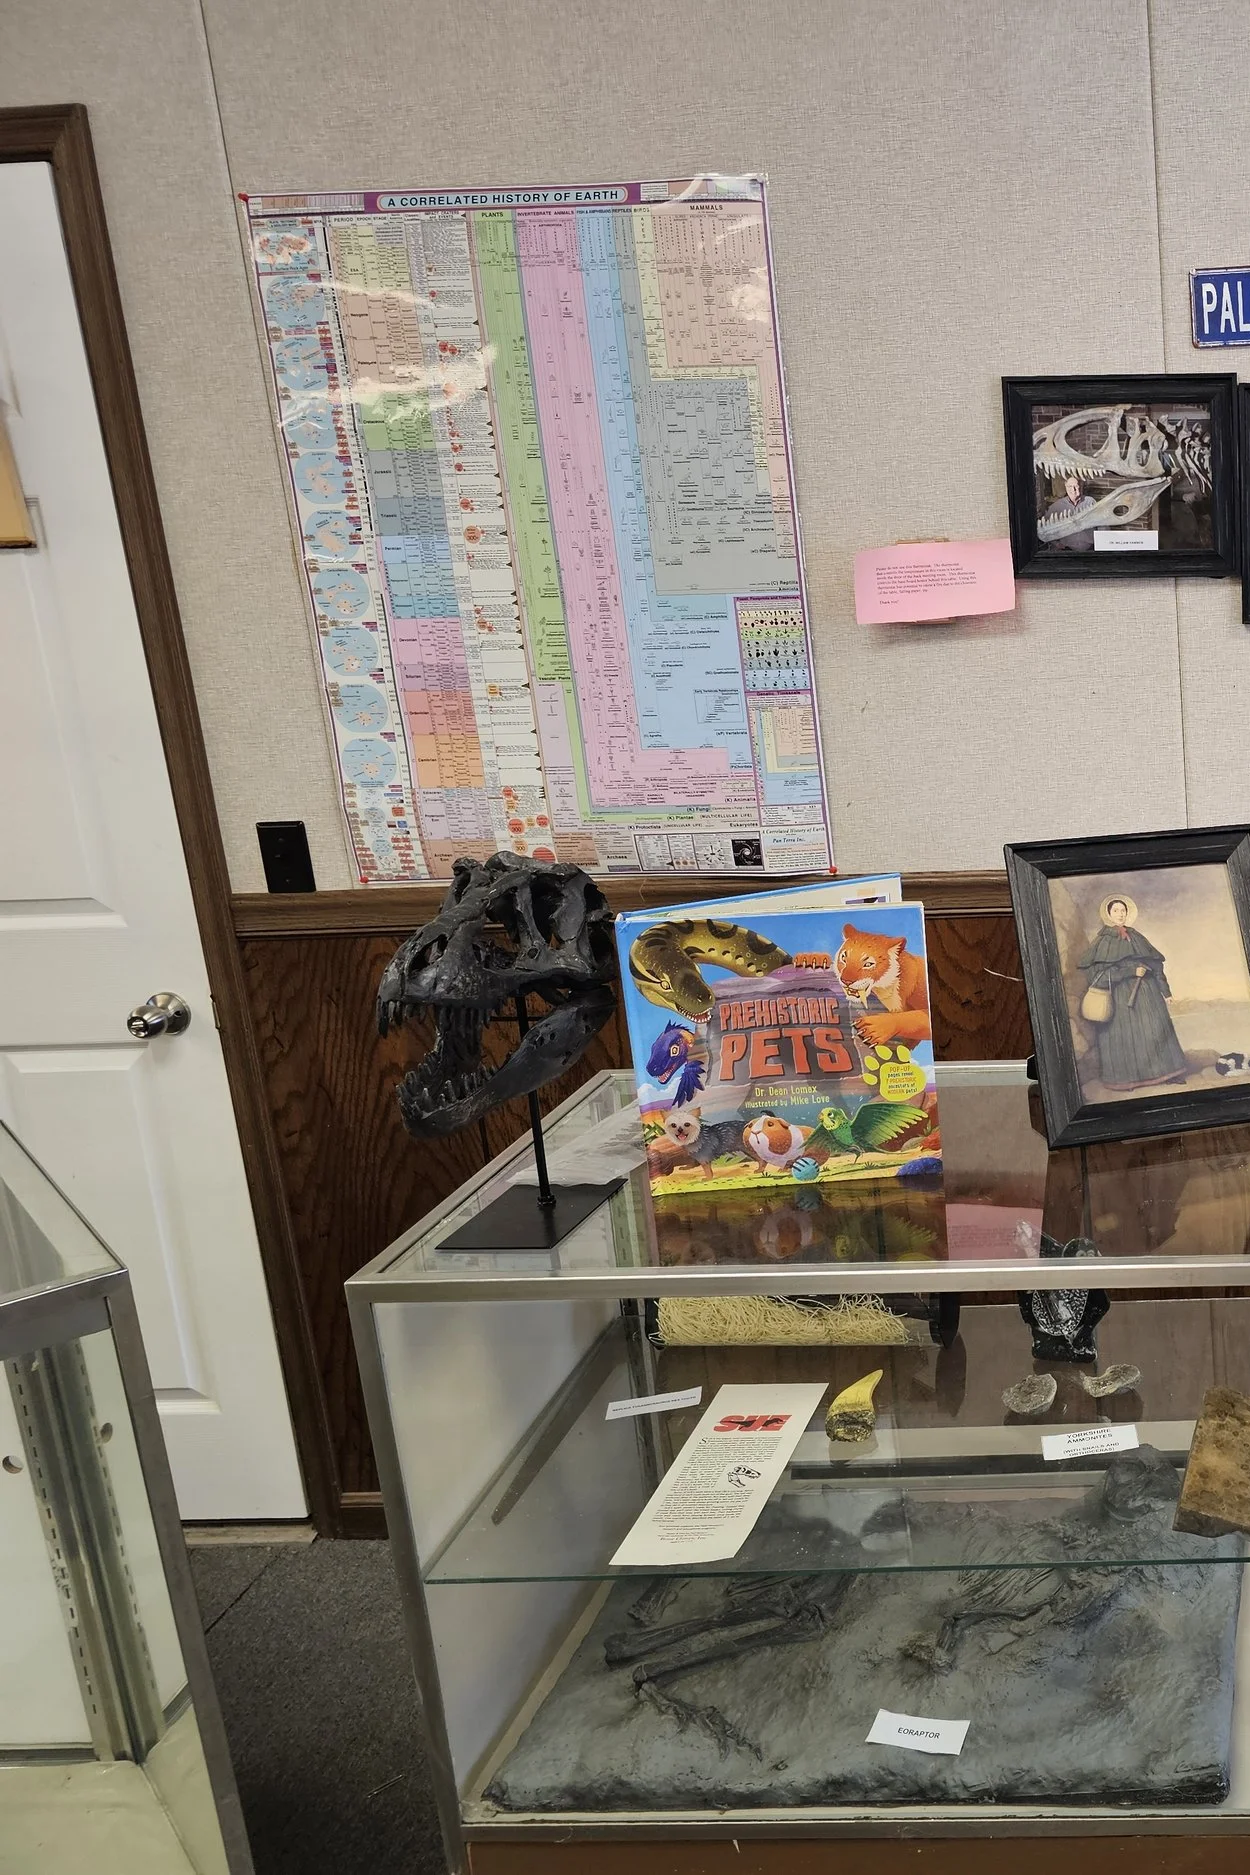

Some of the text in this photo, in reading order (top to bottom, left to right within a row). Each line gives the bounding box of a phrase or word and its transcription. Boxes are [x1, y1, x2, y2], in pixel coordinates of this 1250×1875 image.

[388, 190, 618, 207] A CORRELATED HISTORY OF EARTH
[719, 996, 841, 1031] PREHISTORIC
[719, 1027, 854, 1081] PETS
[755, 1085, 818, 1098] Dr. Dean Lomax
[790, 1096, 809, 1106] Mike
[811, 1094, 830, 1104] Love
[713, 1414, 793, 1433] SUE
[1066, 1428, 1111, 1439] YORKSHIRE
[1067, 1433, 1113, 1444] AMMONITES
[897, 1727, 941, 1739] EORAPTOR
